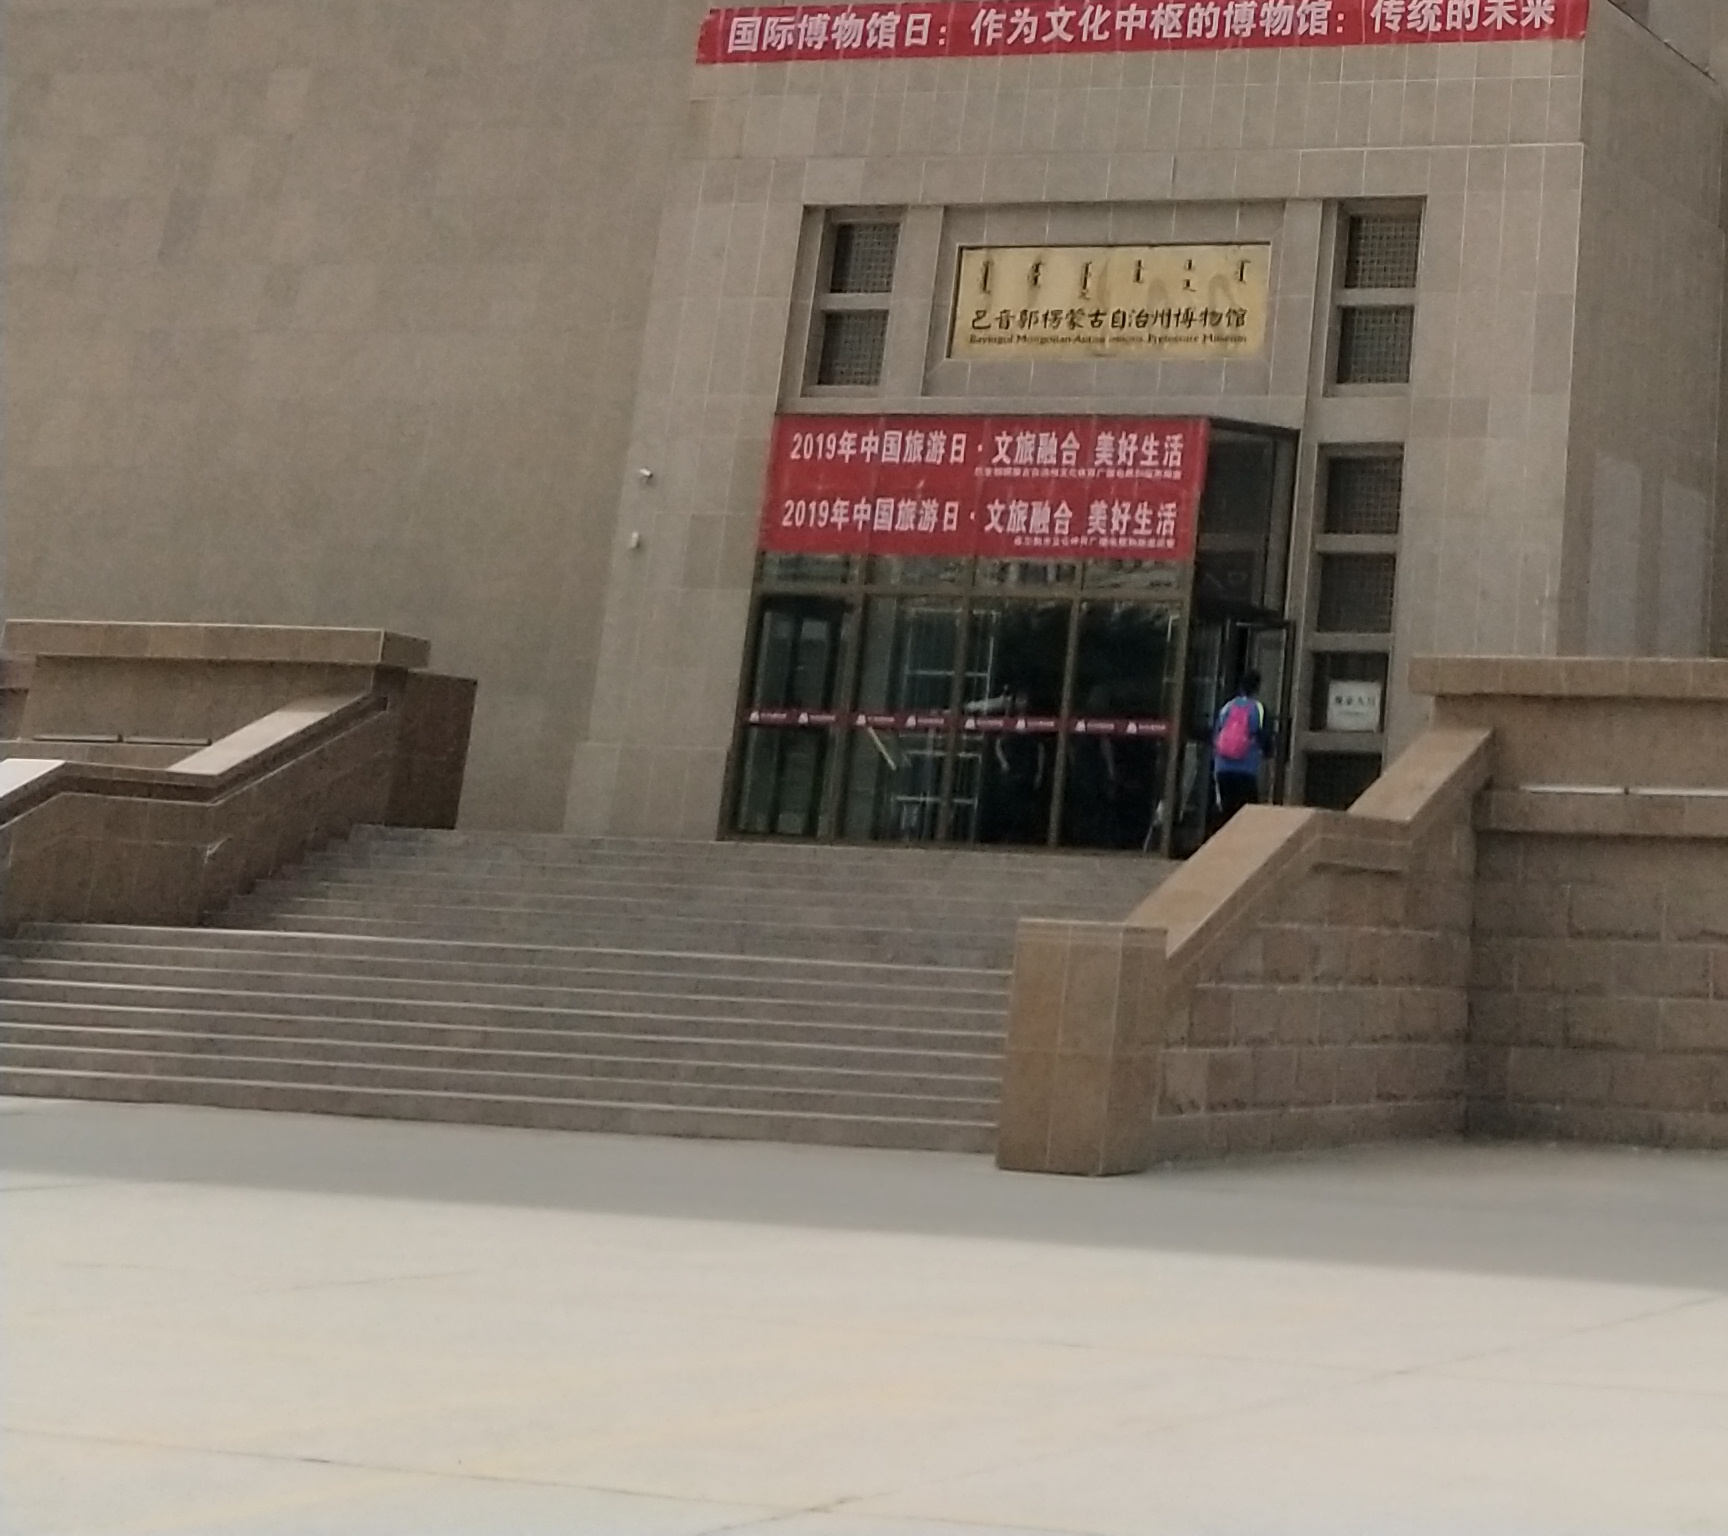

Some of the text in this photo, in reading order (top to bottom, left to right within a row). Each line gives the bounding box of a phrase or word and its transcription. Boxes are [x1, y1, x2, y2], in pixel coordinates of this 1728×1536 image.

[1094, 430, 1184, 468] 美好生活
[1087, 500, 1177, 537] 美好生活
